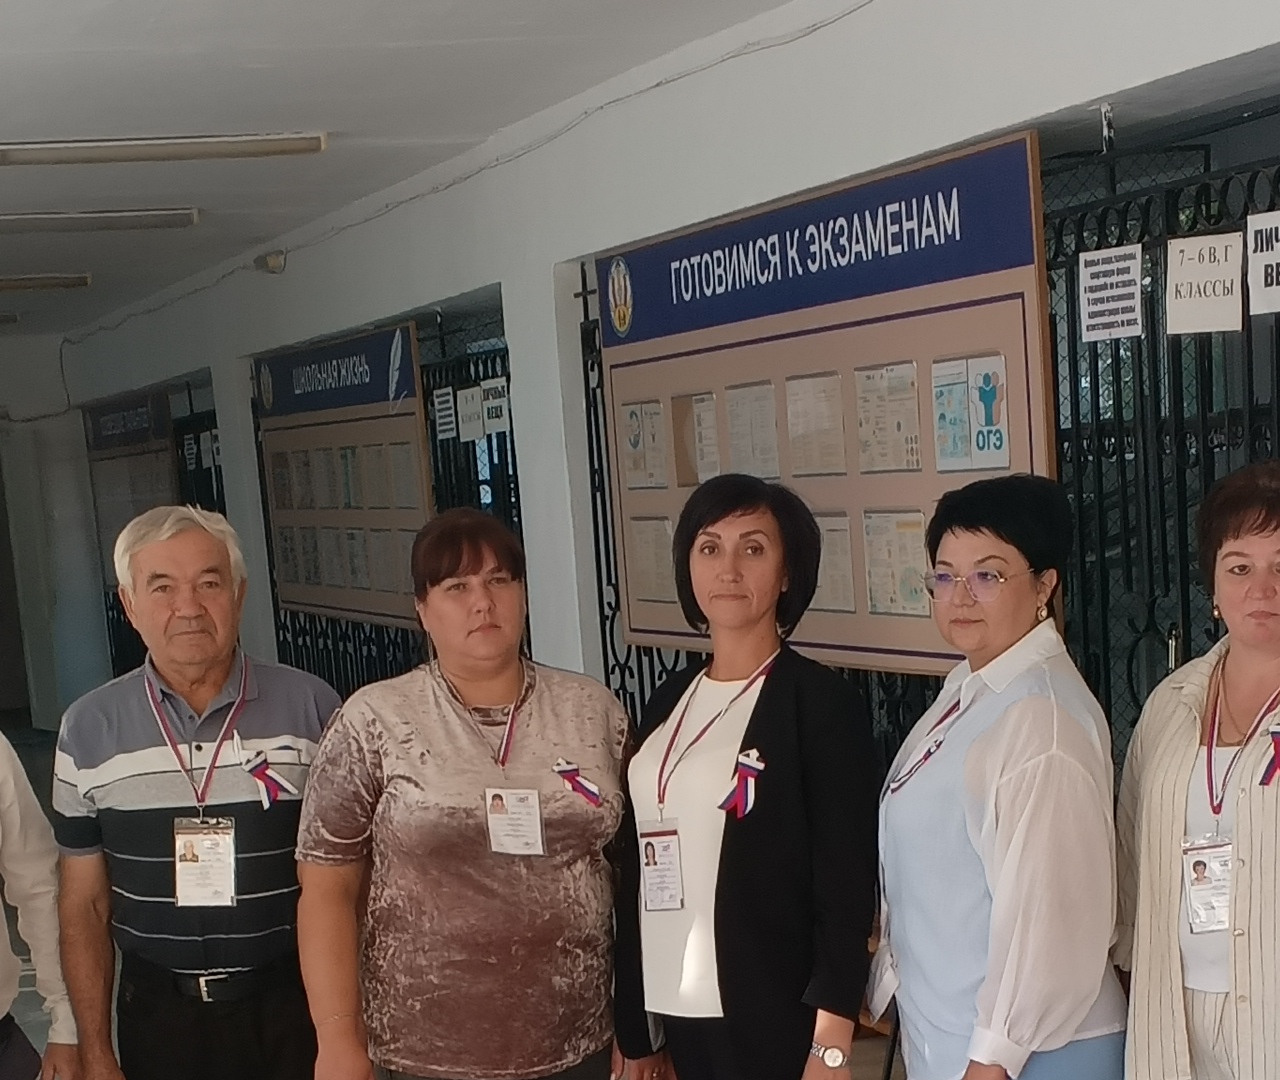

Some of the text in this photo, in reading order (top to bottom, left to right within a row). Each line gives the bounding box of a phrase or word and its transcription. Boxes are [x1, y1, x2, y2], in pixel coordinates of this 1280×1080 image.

[670, 187, 961, 304] ГОТОВИМСЯ К ЭКЗАМЕНАМ
[1178, 249, 1186, 267] 7
[1197, 247, 1205, 265] 6
[1174, 278, 1234, 300] КЛАССЫ
[293, 353, 371, 395] ШКОЛЬНАЯ ЖИЗНЬ
[976, 428, 1004, 451] ОГЭ
